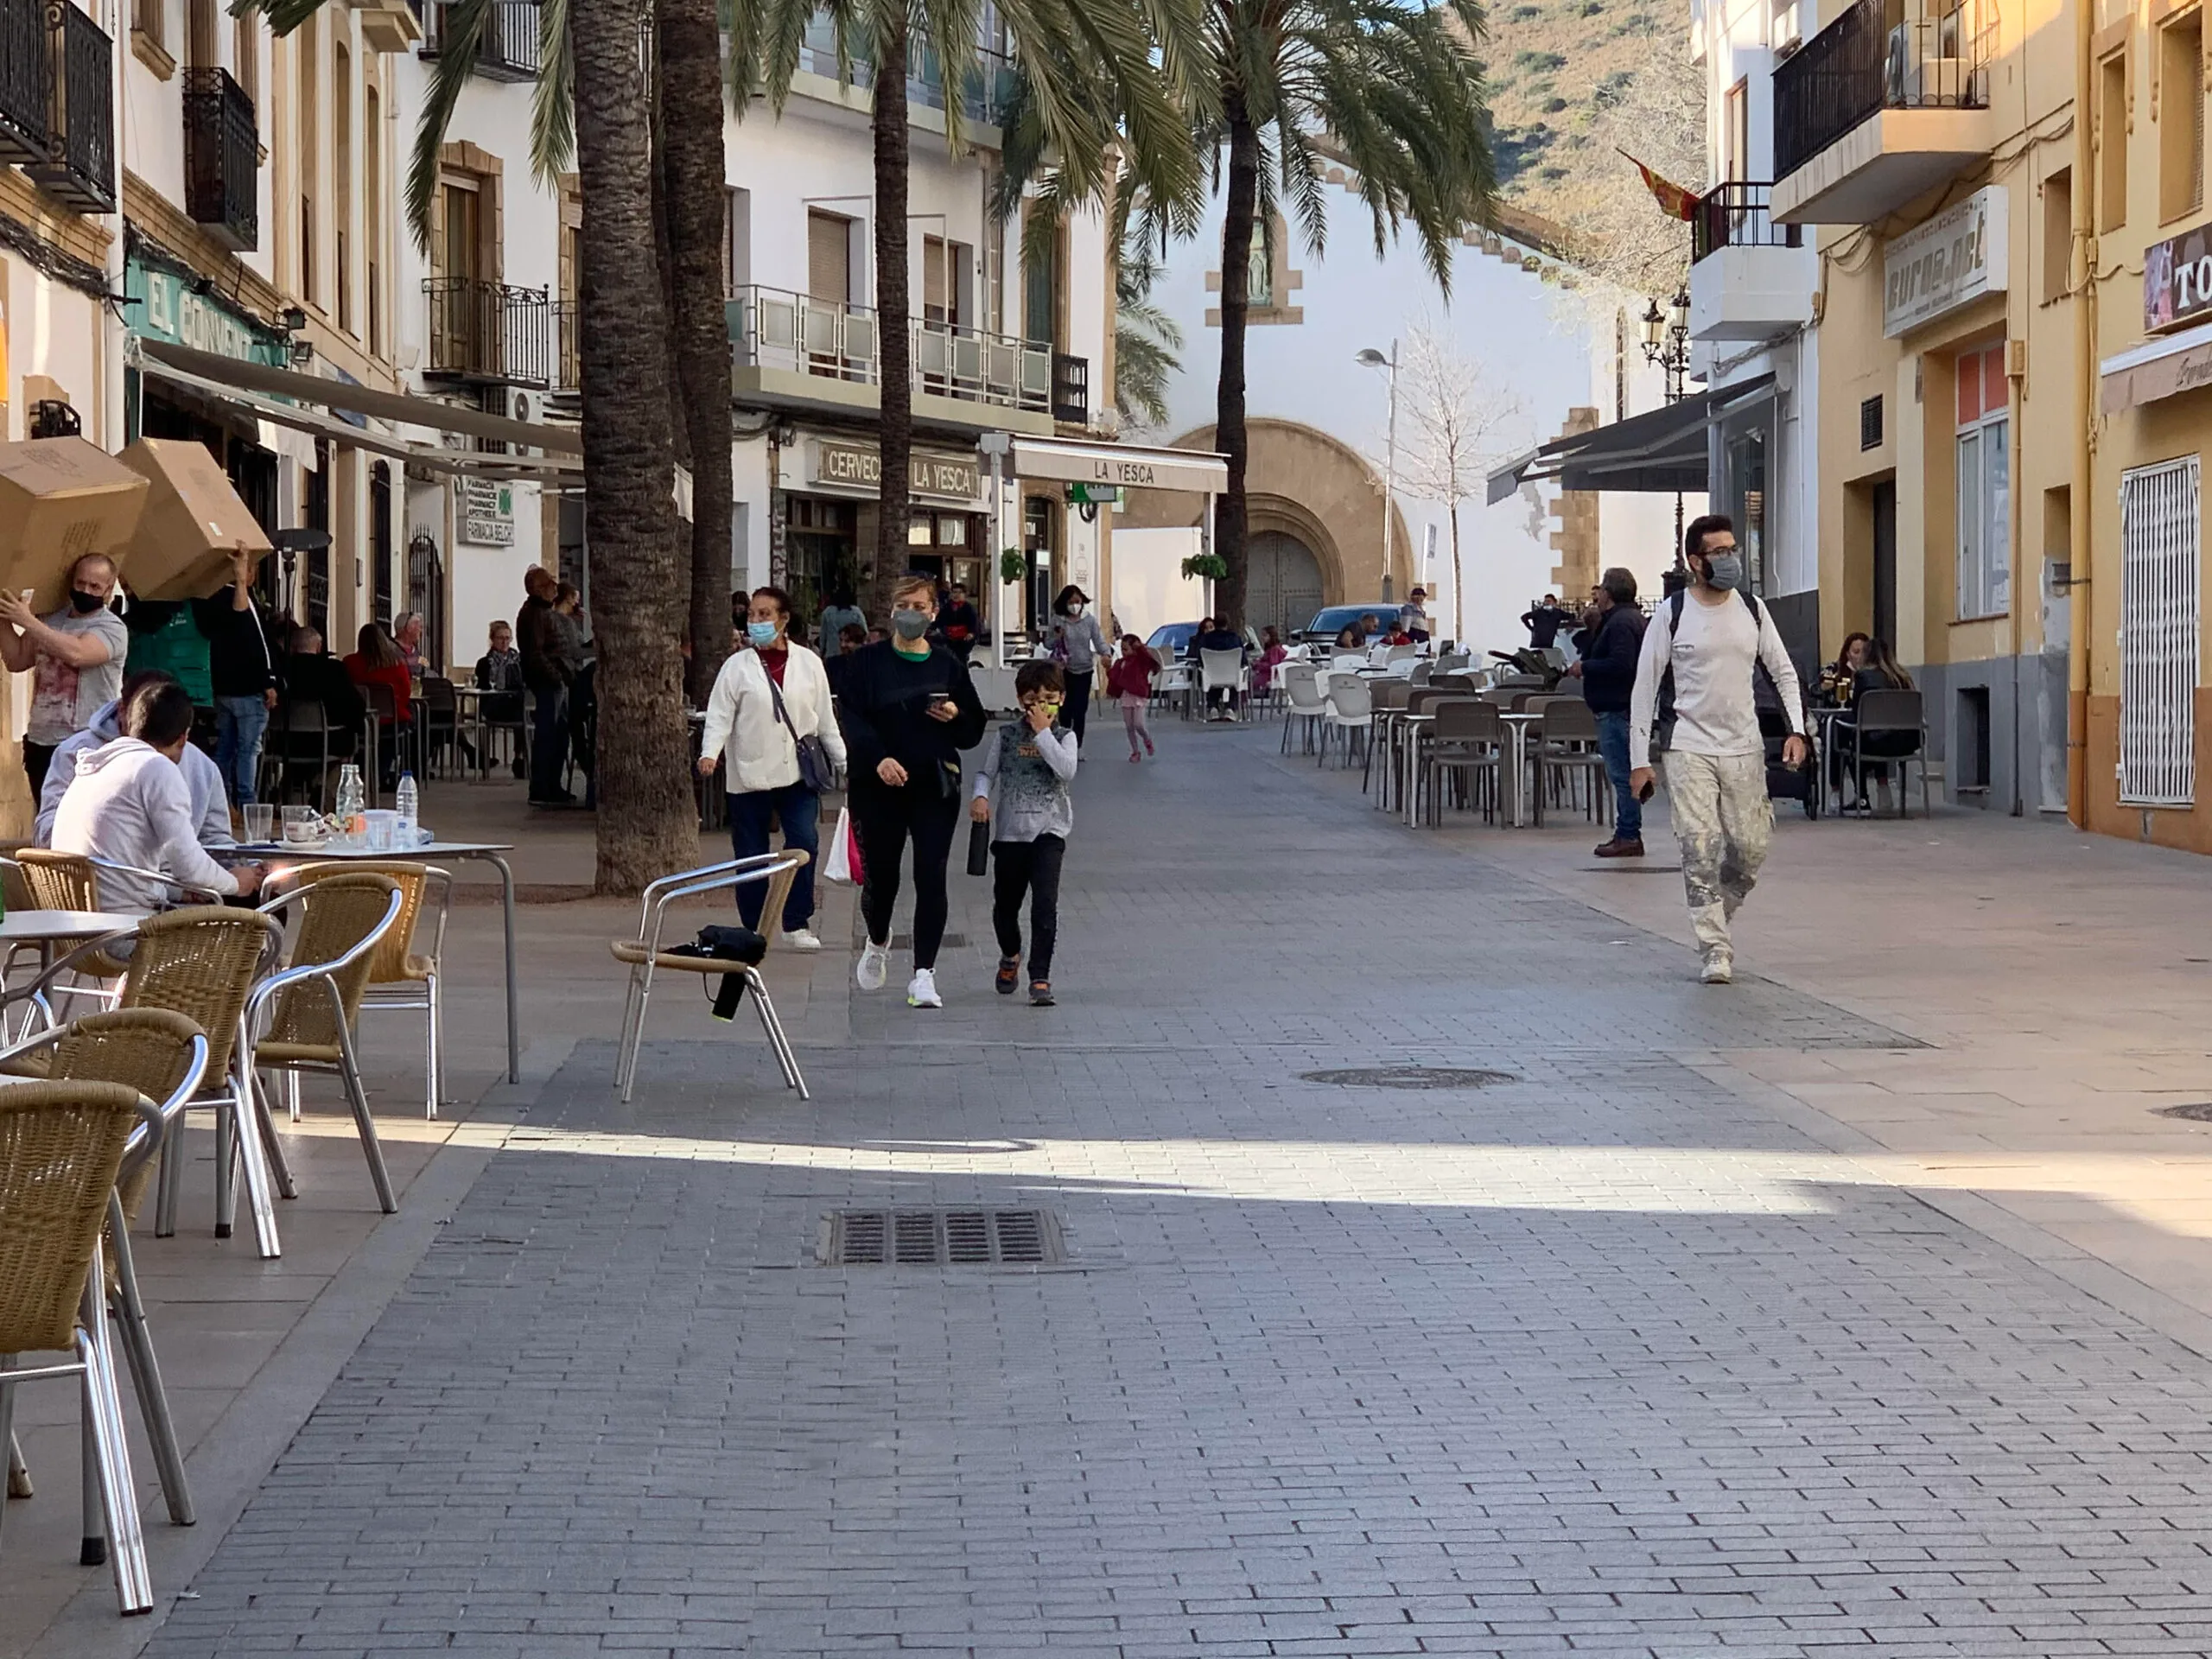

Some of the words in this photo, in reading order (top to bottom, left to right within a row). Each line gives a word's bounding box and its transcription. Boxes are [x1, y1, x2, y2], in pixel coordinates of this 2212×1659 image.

[2175, 255, 2212, 309] TO
[913, 462, 930, 488] LA
[933, 464, 970, 493] YESCA
[1095, 461, 1109, 480] LA
[1116, 463, 1154, 484] YESCA
